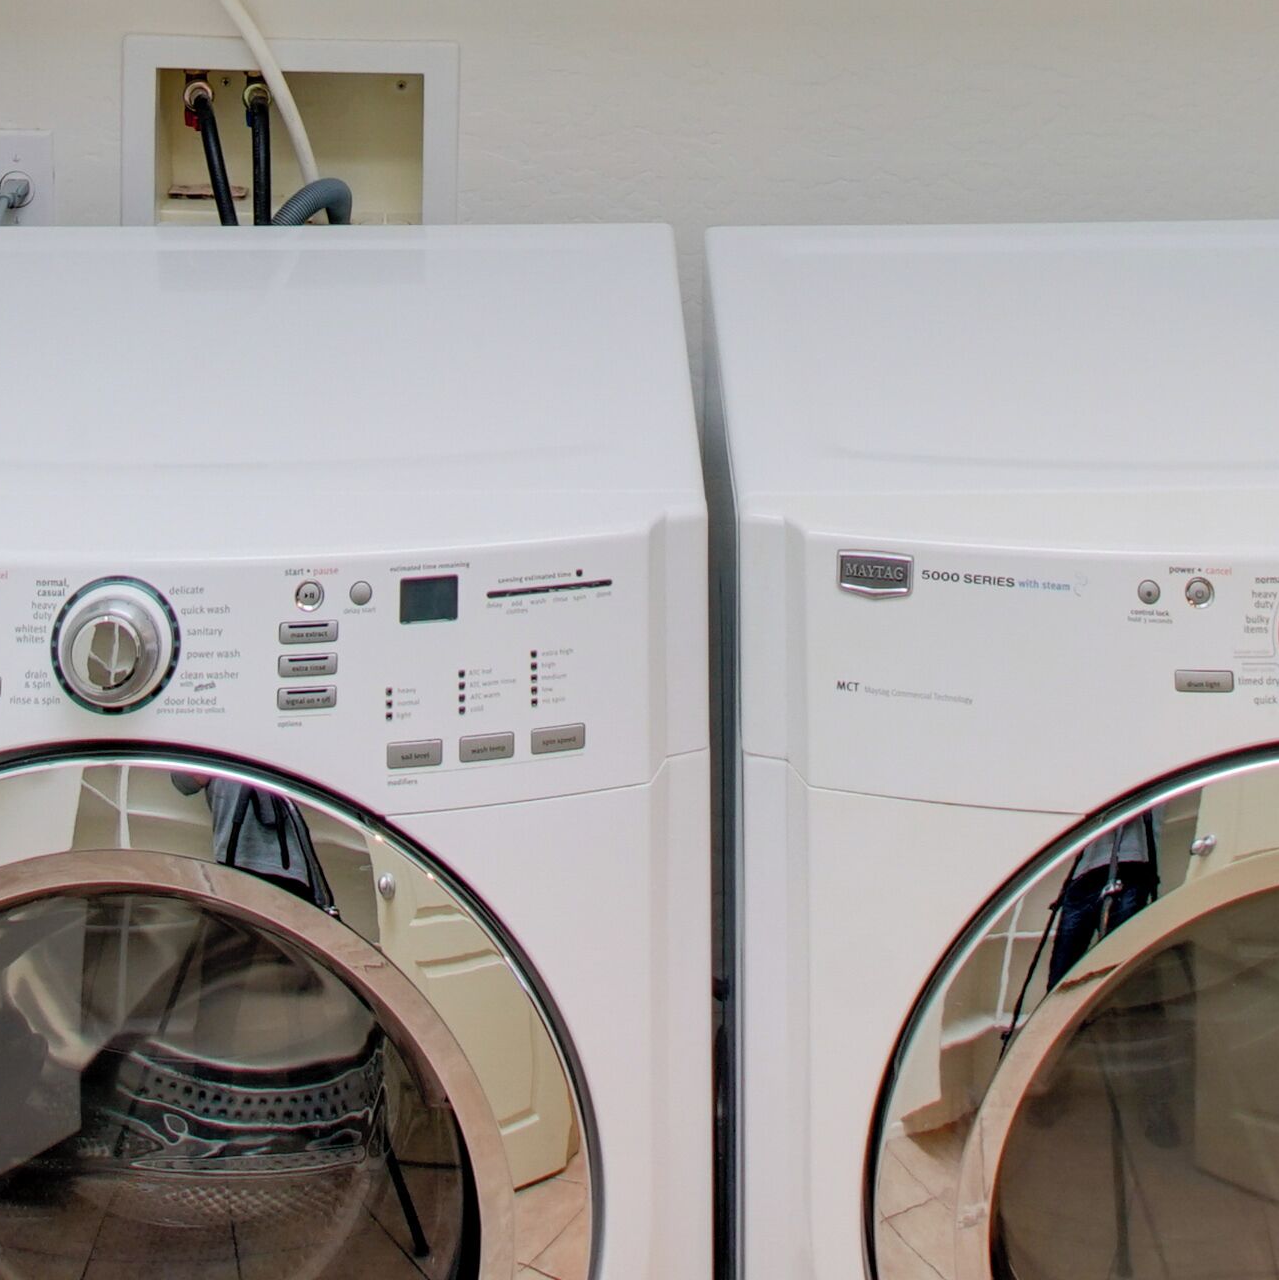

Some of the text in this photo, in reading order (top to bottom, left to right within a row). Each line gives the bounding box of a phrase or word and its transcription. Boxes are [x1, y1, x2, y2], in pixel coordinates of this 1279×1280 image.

[284, 568, 339, 577] start pause
[845, 563, 904, 581] MAYTAG
[1168, 566, 1233, 575] power cancel
[35, 578, 70, 588] normal,
[921, 569, 1071, 591] 5000 SERIES with steam
[37, 588, 65, 597] casual
[169, 586, 205, 595] delicate
[1251, 590, 1277, 599] heavy
[31, 602, 57, 611] heavy
[1254, 600, 1274, 609] duty
[180, 604, 231, 615] quick wash
[33, 611, 52, 621] duty
[1245, 615, 1270, 625] bulky
[14, 624, 47, 633] whitest
[186, 626, 223, 637] sanitary
[1243, 625, 1269, 634] items
[15, 634, 45, 643] whites
[186, 648, 241, 659] power wash
[24, 670, 48, 679] drain
[180, 670, 240, 680] clean washer
[32, 680, 51, 689] spin
[1238, 676, 1263, 685] timed
[836, 681, 860, 692] MCT
[9, 696, 32, 705] rinse
[42, 696, 61, 706] spin
[164, 696, 217, 706] door locked
[1253, 695, 1278, 705] quick
